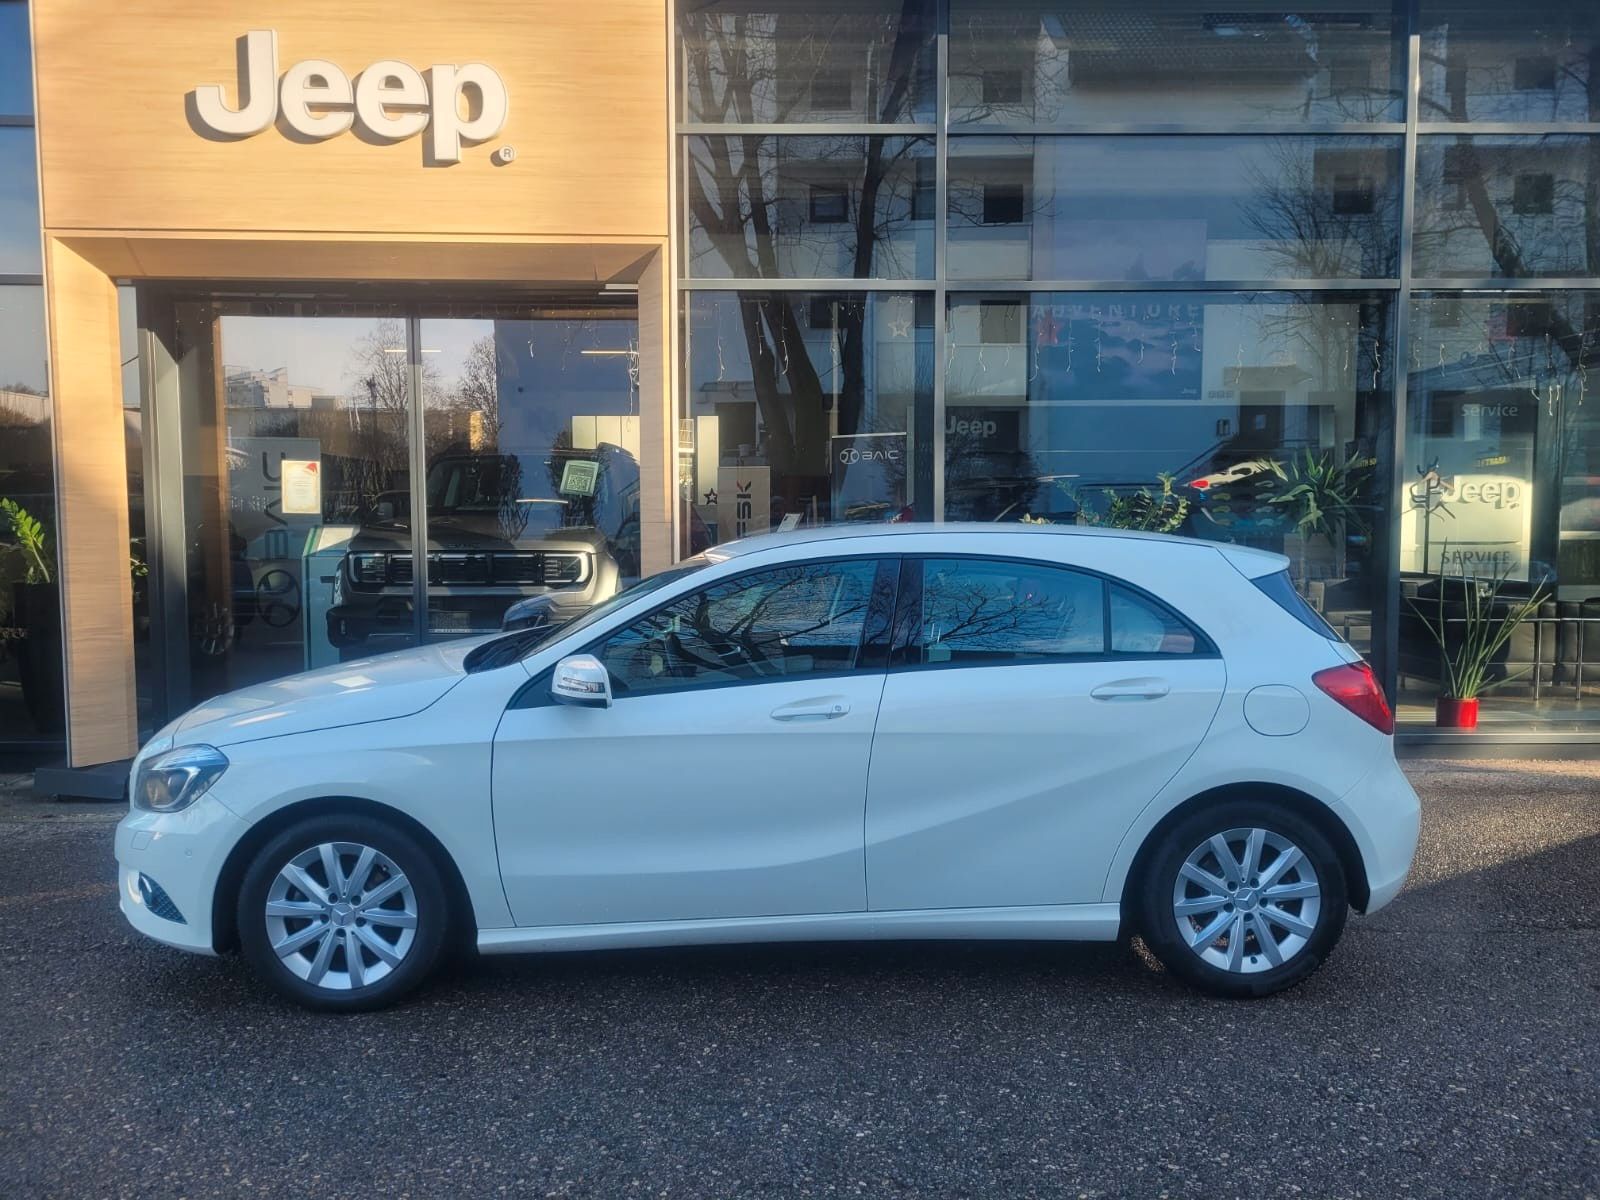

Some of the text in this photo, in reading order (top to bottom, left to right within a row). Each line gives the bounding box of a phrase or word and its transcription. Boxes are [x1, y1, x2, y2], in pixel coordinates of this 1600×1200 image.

[194, 29, 508, 162] Jeep
[945, 415, 997, 438] Jeep
[862, 450, 899, 461] BAIC
[1441, 477, 1521, 509] Jeep
